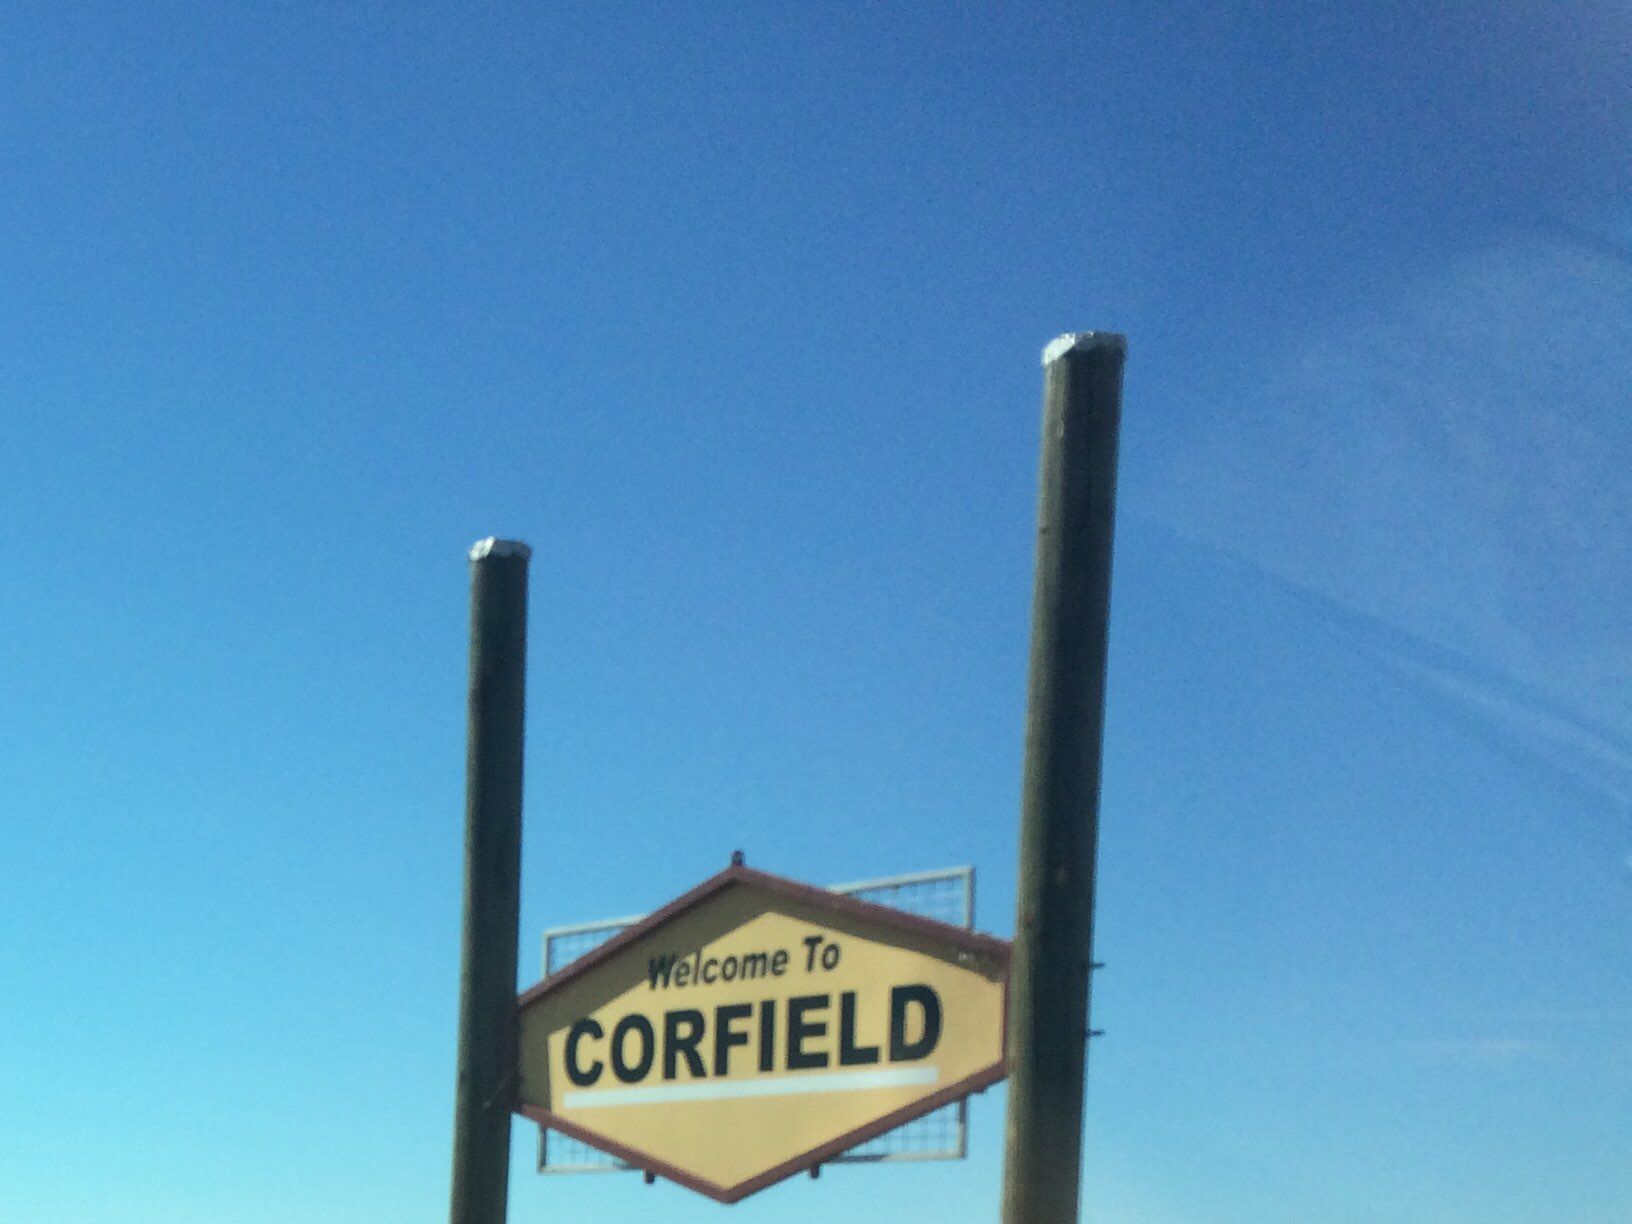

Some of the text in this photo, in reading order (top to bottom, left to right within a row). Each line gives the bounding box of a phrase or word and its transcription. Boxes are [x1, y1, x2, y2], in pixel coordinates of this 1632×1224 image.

[649, 935, 841, 990] Welcome To
[565, 983, 943, 1087] CORFIELD
